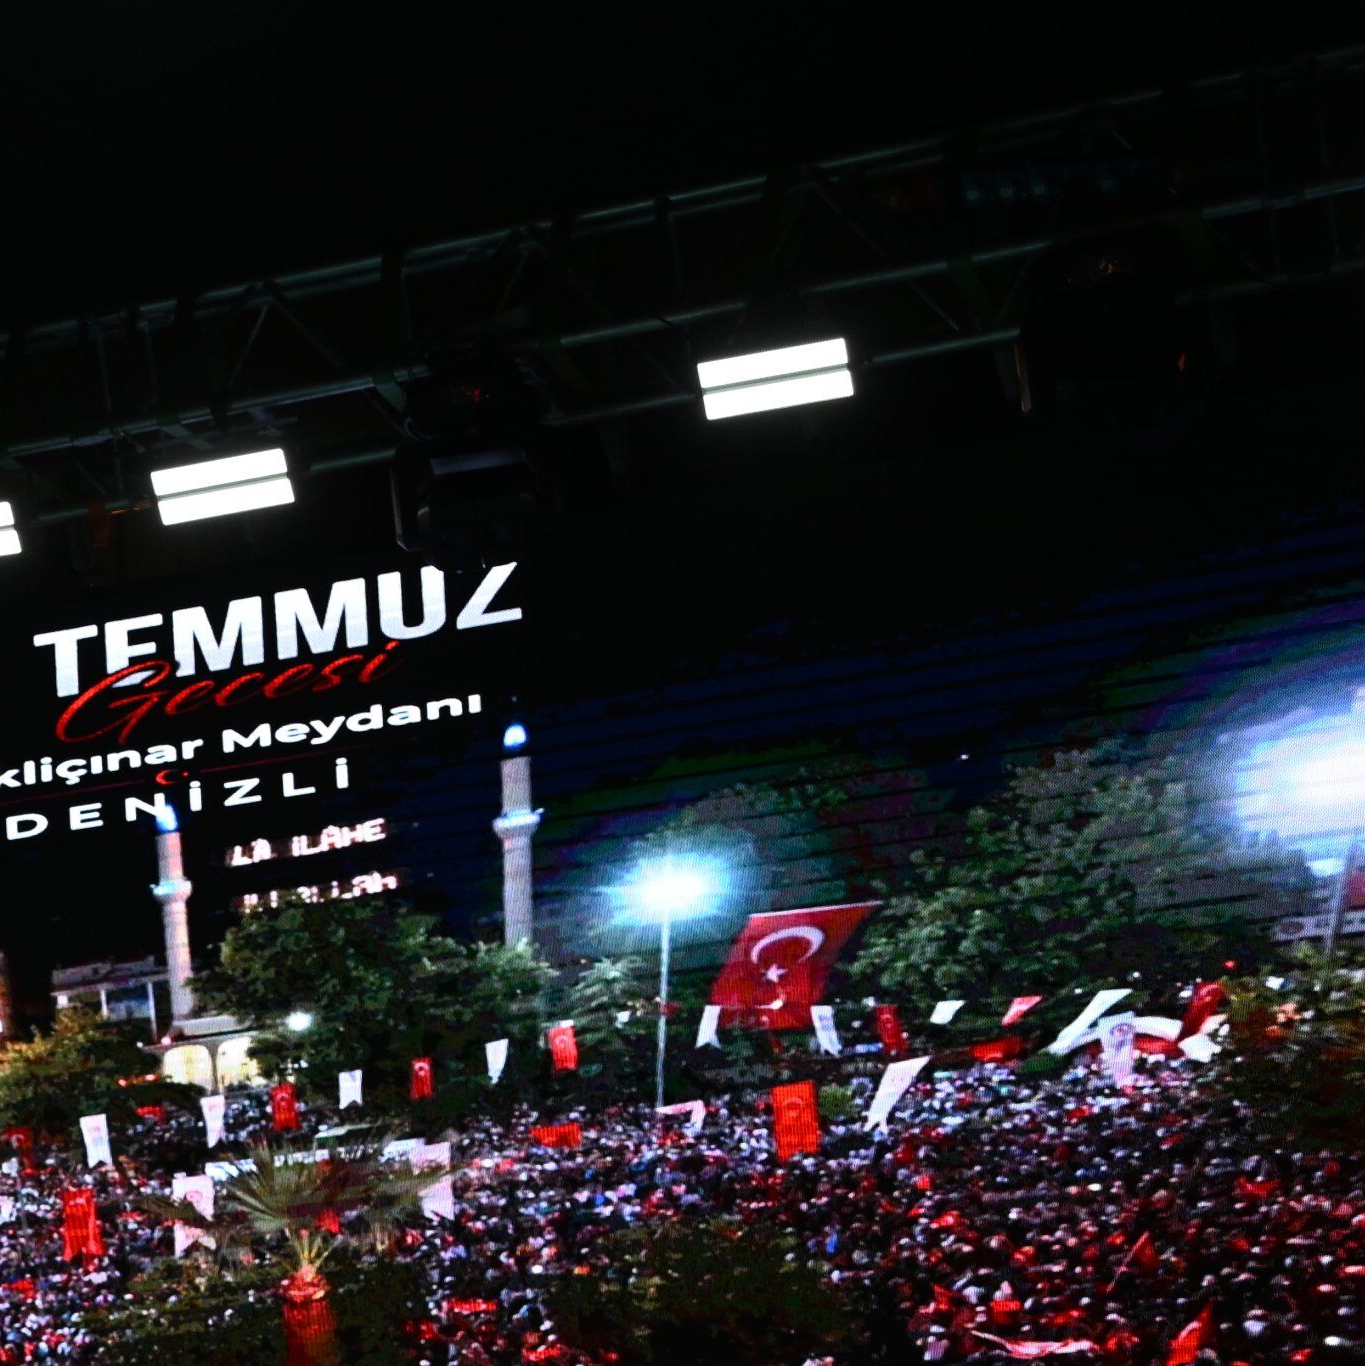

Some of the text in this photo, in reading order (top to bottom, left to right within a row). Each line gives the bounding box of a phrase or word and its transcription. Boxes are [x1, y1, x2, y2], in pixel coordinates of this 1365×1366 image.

[33, 561, 523, 698] TEMMUZ
[56, 640, 399, 745] Gecesi
[221, 694, 482, 754] Meydanı
[5, 757, 349, 841] DENİZLİ
